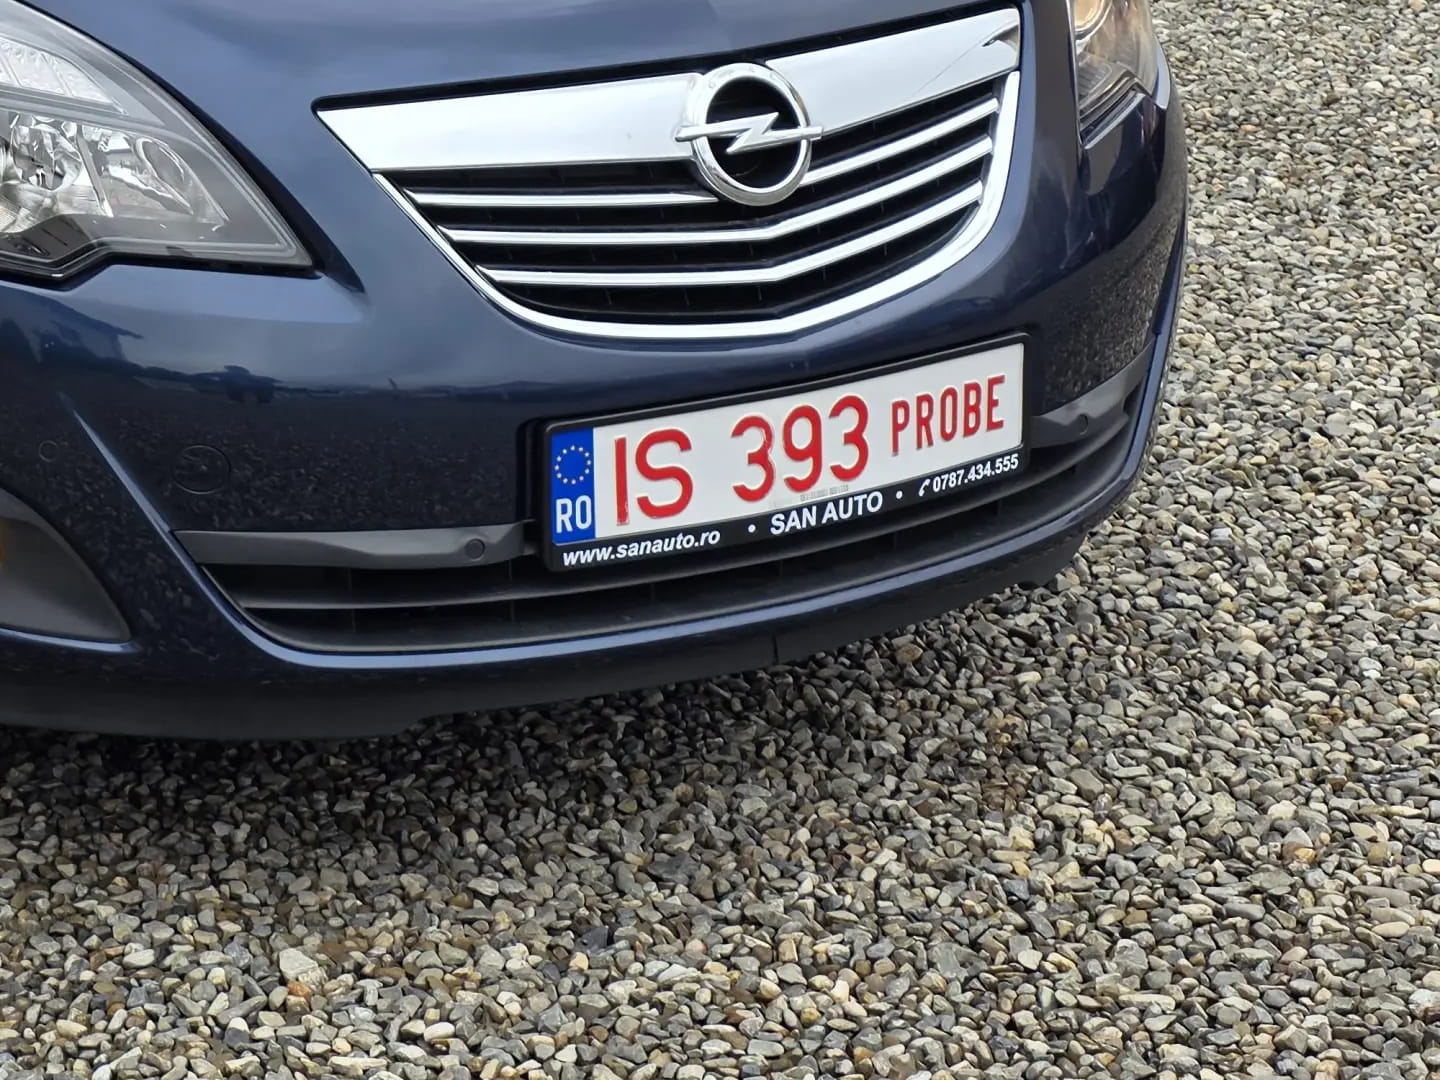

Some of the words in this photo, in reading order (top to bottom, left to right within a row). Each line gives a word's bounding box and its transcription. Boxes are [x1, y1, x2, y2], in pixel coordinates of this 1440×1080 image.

[613, 427, 694, 526] IS
[731, 394, 869, 503] 393
[891, 374, 1005, 457] PROBE
[555, 494, 593, 534] RO
[562, 528, 721, 567] www.sanauto.ro
[769, 507, 818, 536] SAN
[821, 491, 883, 525] AUTO
[932, 454, 1019, 494] 0787.434.555
